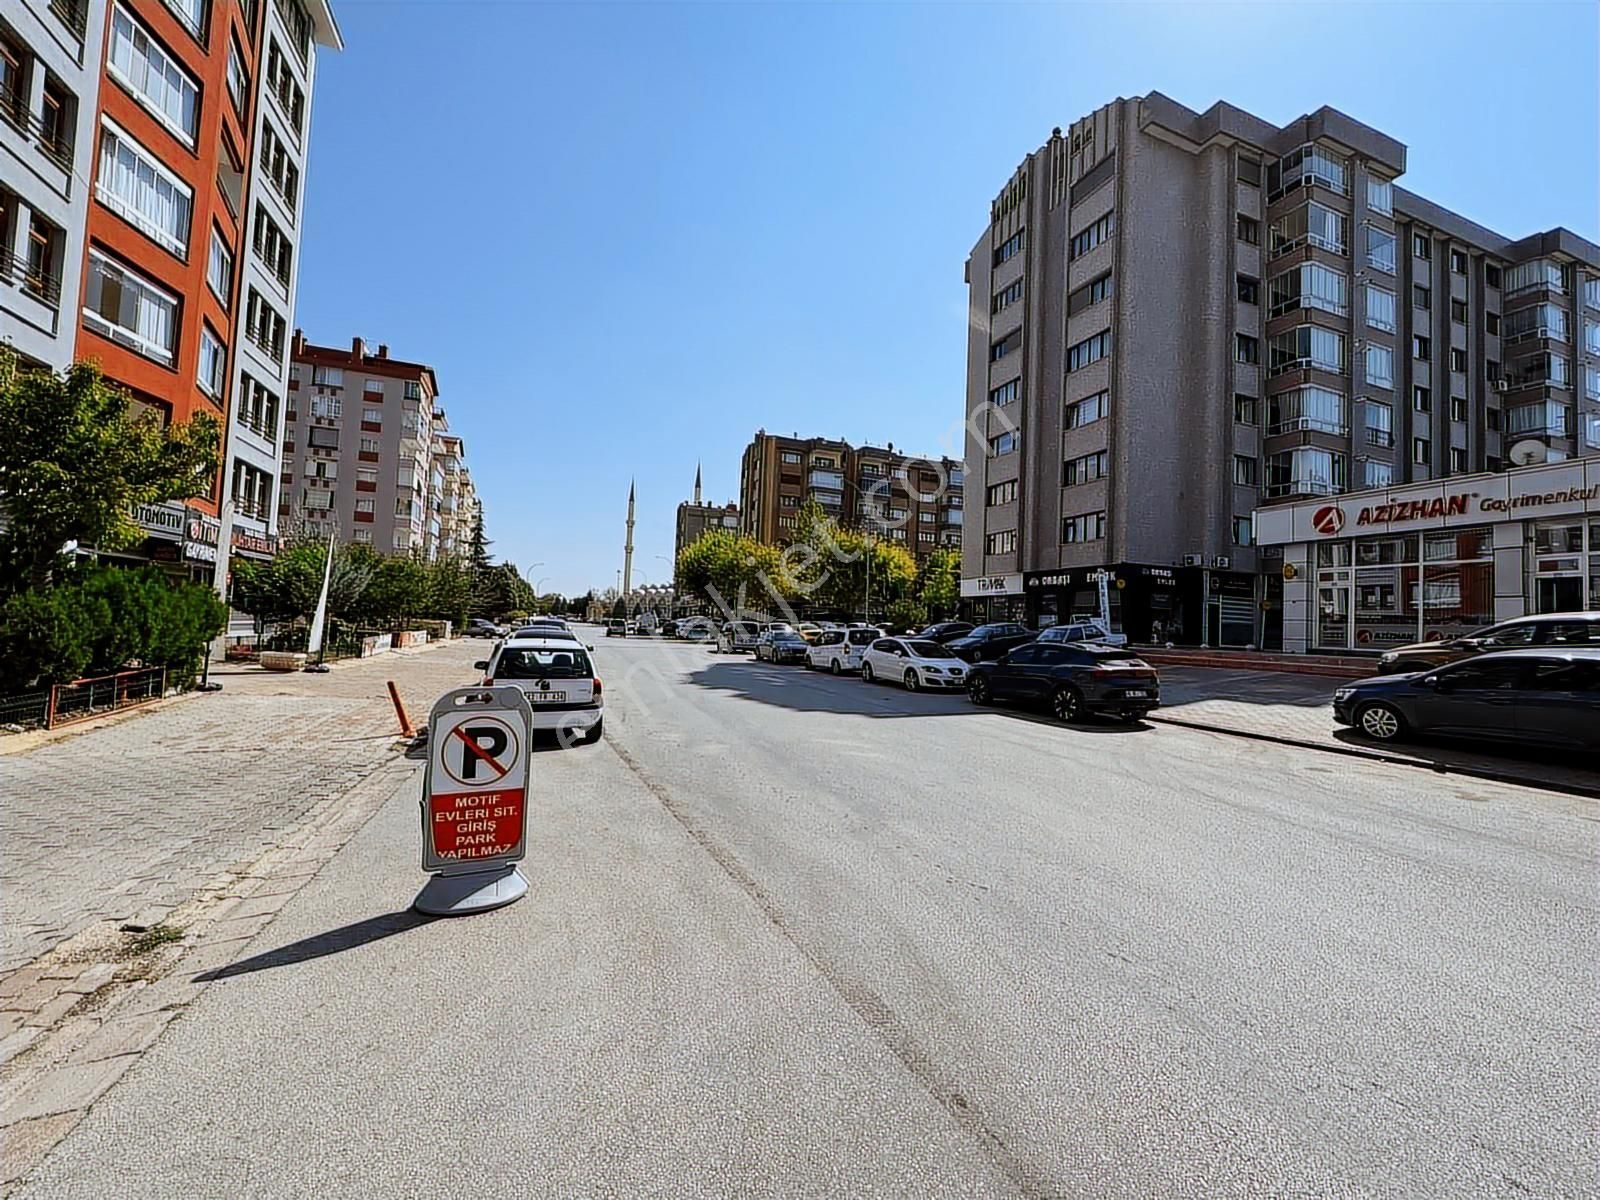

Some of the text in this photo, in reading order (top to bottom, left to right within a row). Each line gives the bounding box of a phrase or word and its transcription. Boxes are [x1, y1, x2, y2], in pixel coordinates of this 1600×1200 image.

[1480, 484, 1600, 512] Gayrimenkul
[455, 833, 496, 847] PARK
[438, 843, 513, 859] YAPILMAZ
